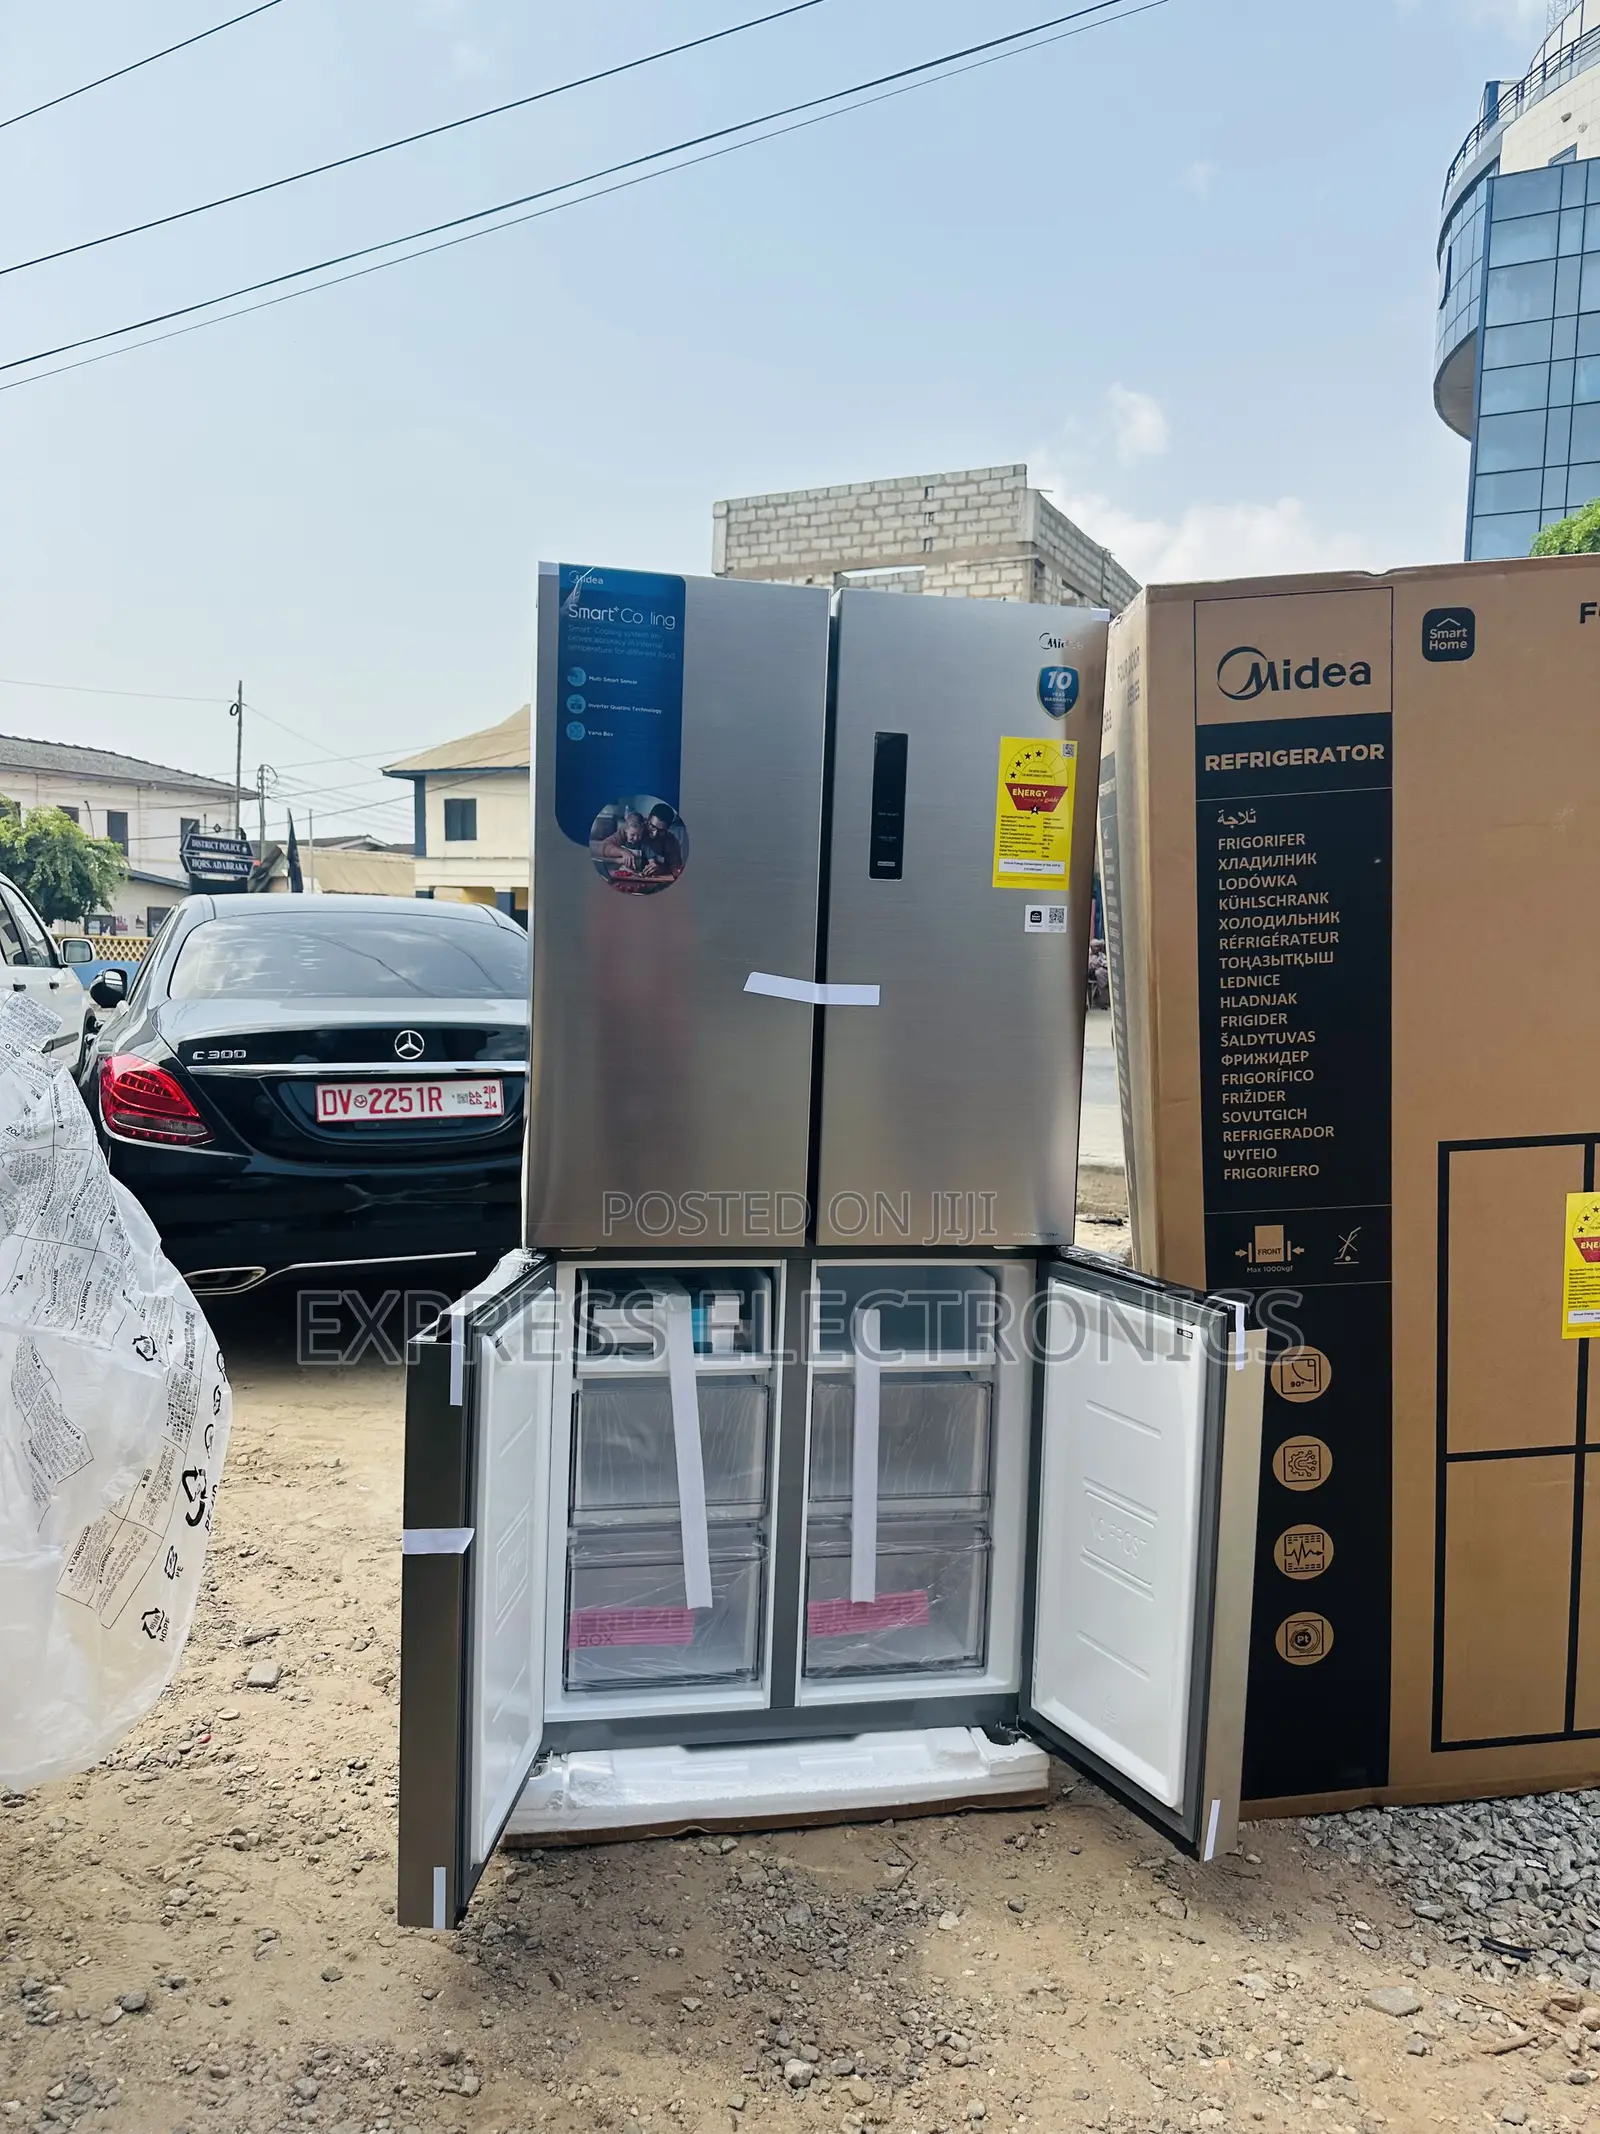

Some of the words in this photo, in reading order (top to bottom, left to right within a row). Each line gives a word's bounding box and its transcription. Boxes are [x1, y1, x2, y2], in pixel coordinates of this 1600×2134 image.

[620, 607, 676, 630] Coling
[1580, 602, 1600, 624] F
[1429, 627, 1468, 640] Smart
[1429, 638, 1468, 651] Home
[1047, 670, 1072, 690] 10
[1217, 645, 1372, 701] Midea
[1205, 744, 1385, 772] REFRIGERATOR
[1012, 787, 1048, 798] ENERGY
[1217, 808, 1257, 829] ثلاجة
[220, 842, 241, 852] POLICE
[1218, 833, 1306, 851] FRIGORIFER
[1218, 852, 1318, 871] ХЛАДИЛНИК
[1218, 873, 1298, 891] LODÓWKA
[1219, 892, 1329, 911] KÜHLSCHRANK
[1218, 911, 1341, 931] ХОЛОДИЛЬНИК
[1219, 931, 1340, 950] RÉFRIGÉRATEUR
[1220, 974, 1281, 989] LEDNICE
[1220, 992, 1298, 1009] HLADNJAK
[1220, 1013, 1288, 1028] FRIGIDER
[1220, 1030, 1316, 1048] ŠALDYTUVAS
[207, 1049, 247, 1060] 300
[1221, 1050, 1309, 1066] ФРИЖИДЕР
[1221, 1068, 1314, 1086] FRIGORÍFICO
[322, 1089, 350, 1116] DV
[369, 1086, 443, 1115] 2251R
[1222, 1089, 1286, 1105] FRIŽIDER
[1222, 1108, 1308, 1124] SOVUTGICH
[1223, 1126, 1335, 1143] REFRIGERADOR
[1224, 1164, 1320, 1180] FRIGORIFERO
[1257, 1247, 1282, 1256] FRONT
[1580, 1241, 1600, 1250] ENE
[1246, 1266, 1262, 1274] Max
[78, 1280, 93, 1314] VARNING
[100, 1546, 115, 1576] VARNING
[175, 1566, 184, 1578] PE
[577, 1633, 615, 1647] BOX
[1297, 1634, 1310, 1644] Pt
